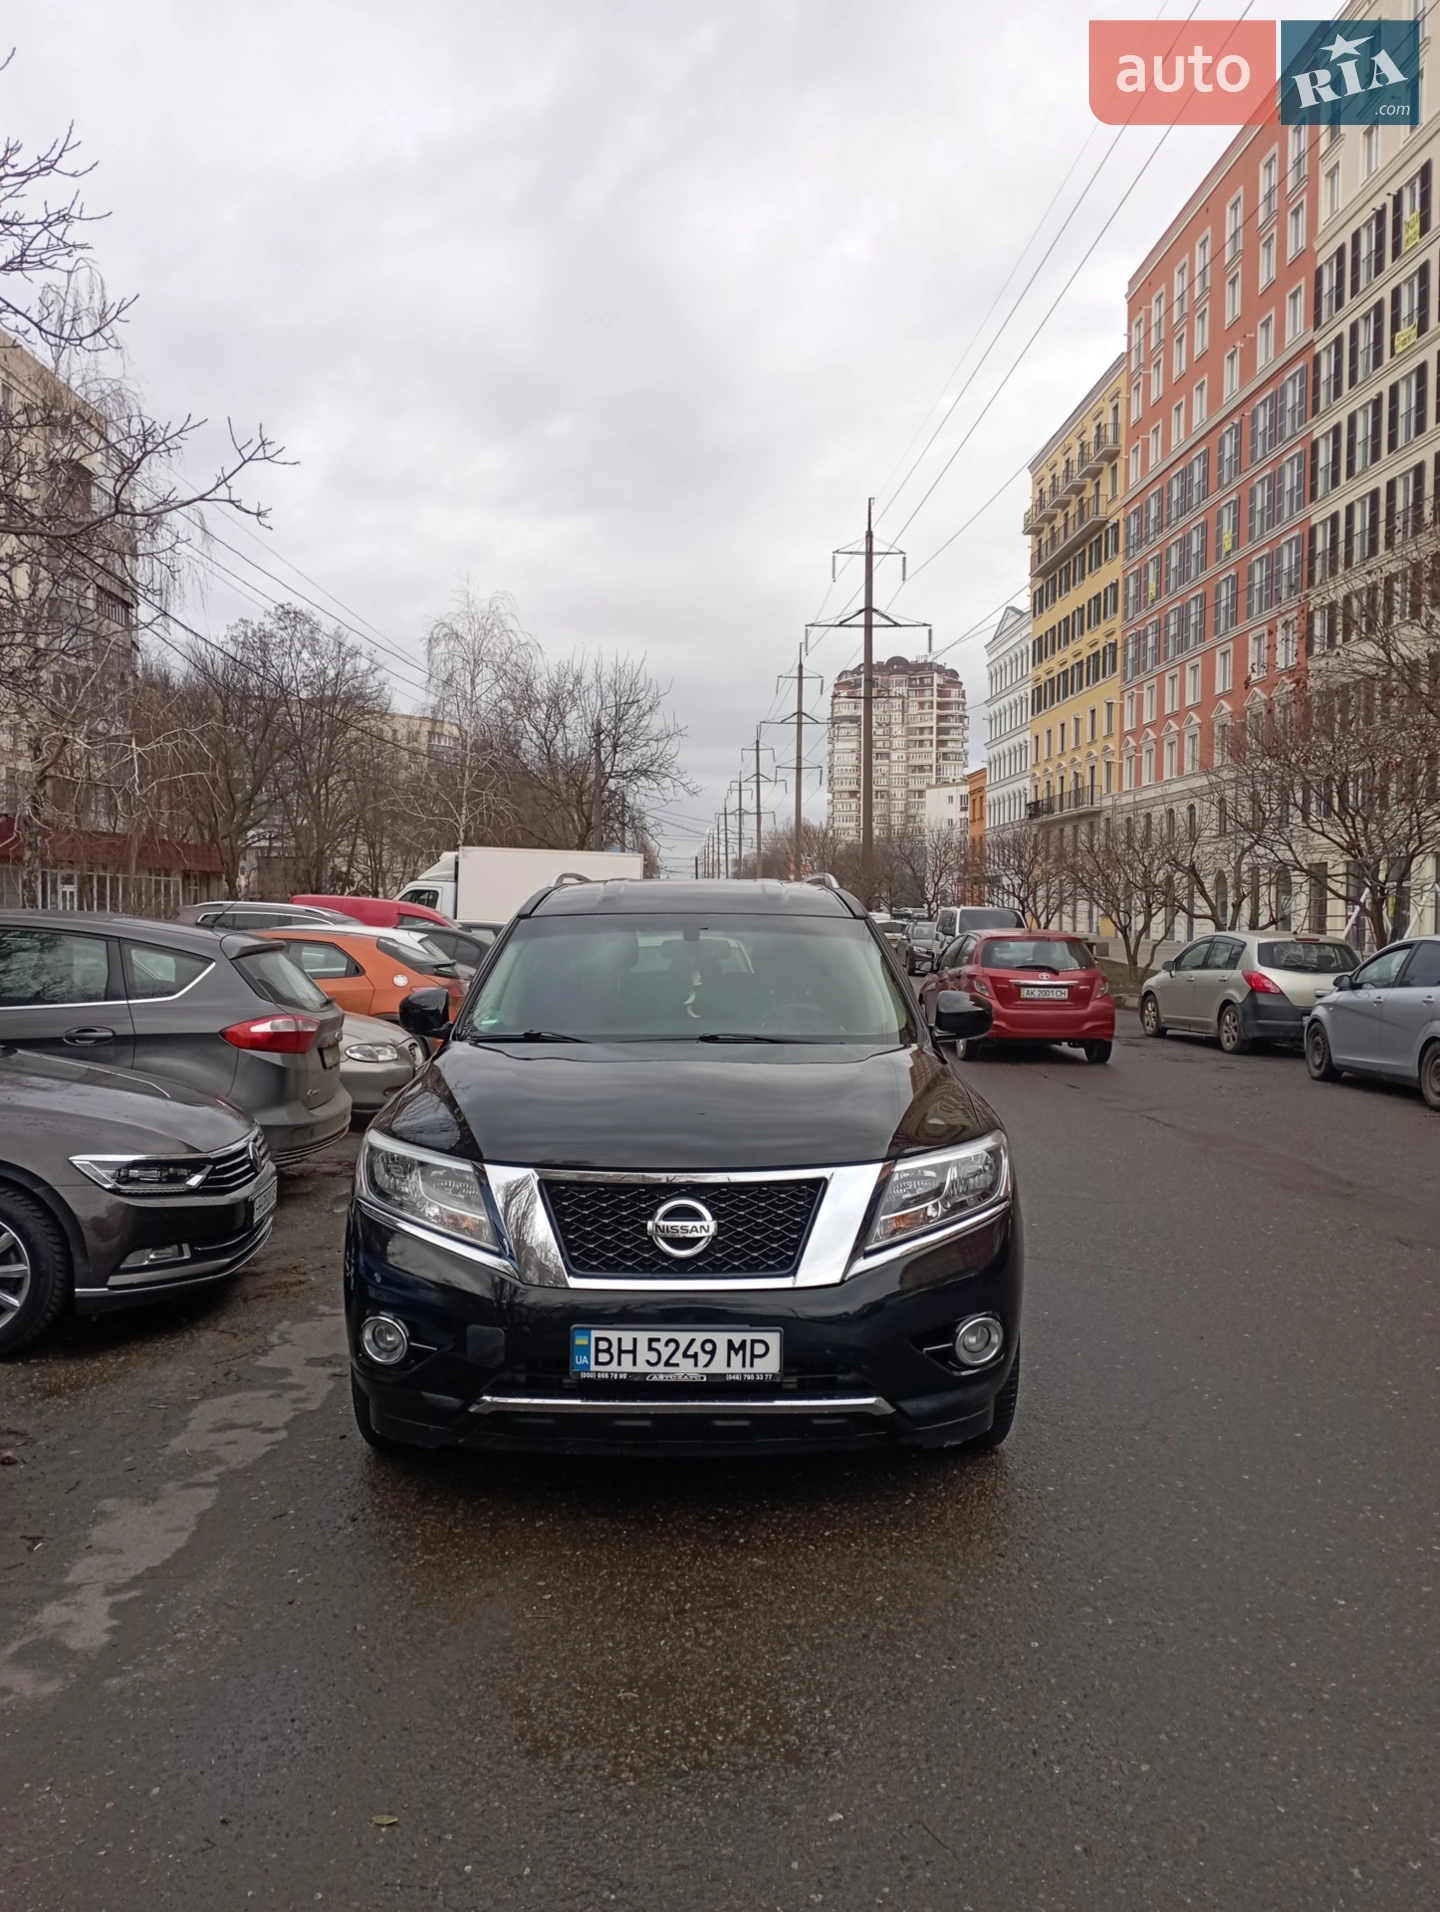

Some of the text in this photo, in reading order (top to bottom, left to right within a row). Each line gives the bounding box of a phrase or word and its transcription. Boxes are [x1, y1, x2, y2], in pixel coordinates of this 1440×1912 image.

[1025, 989, 1066, 997] AK 2001 CH
[655, 1224, 710, 1234] NISSAN
[594, 1336, 770, 1368] BH 5249 MP
[575, 1355, 589, 1365] UA
